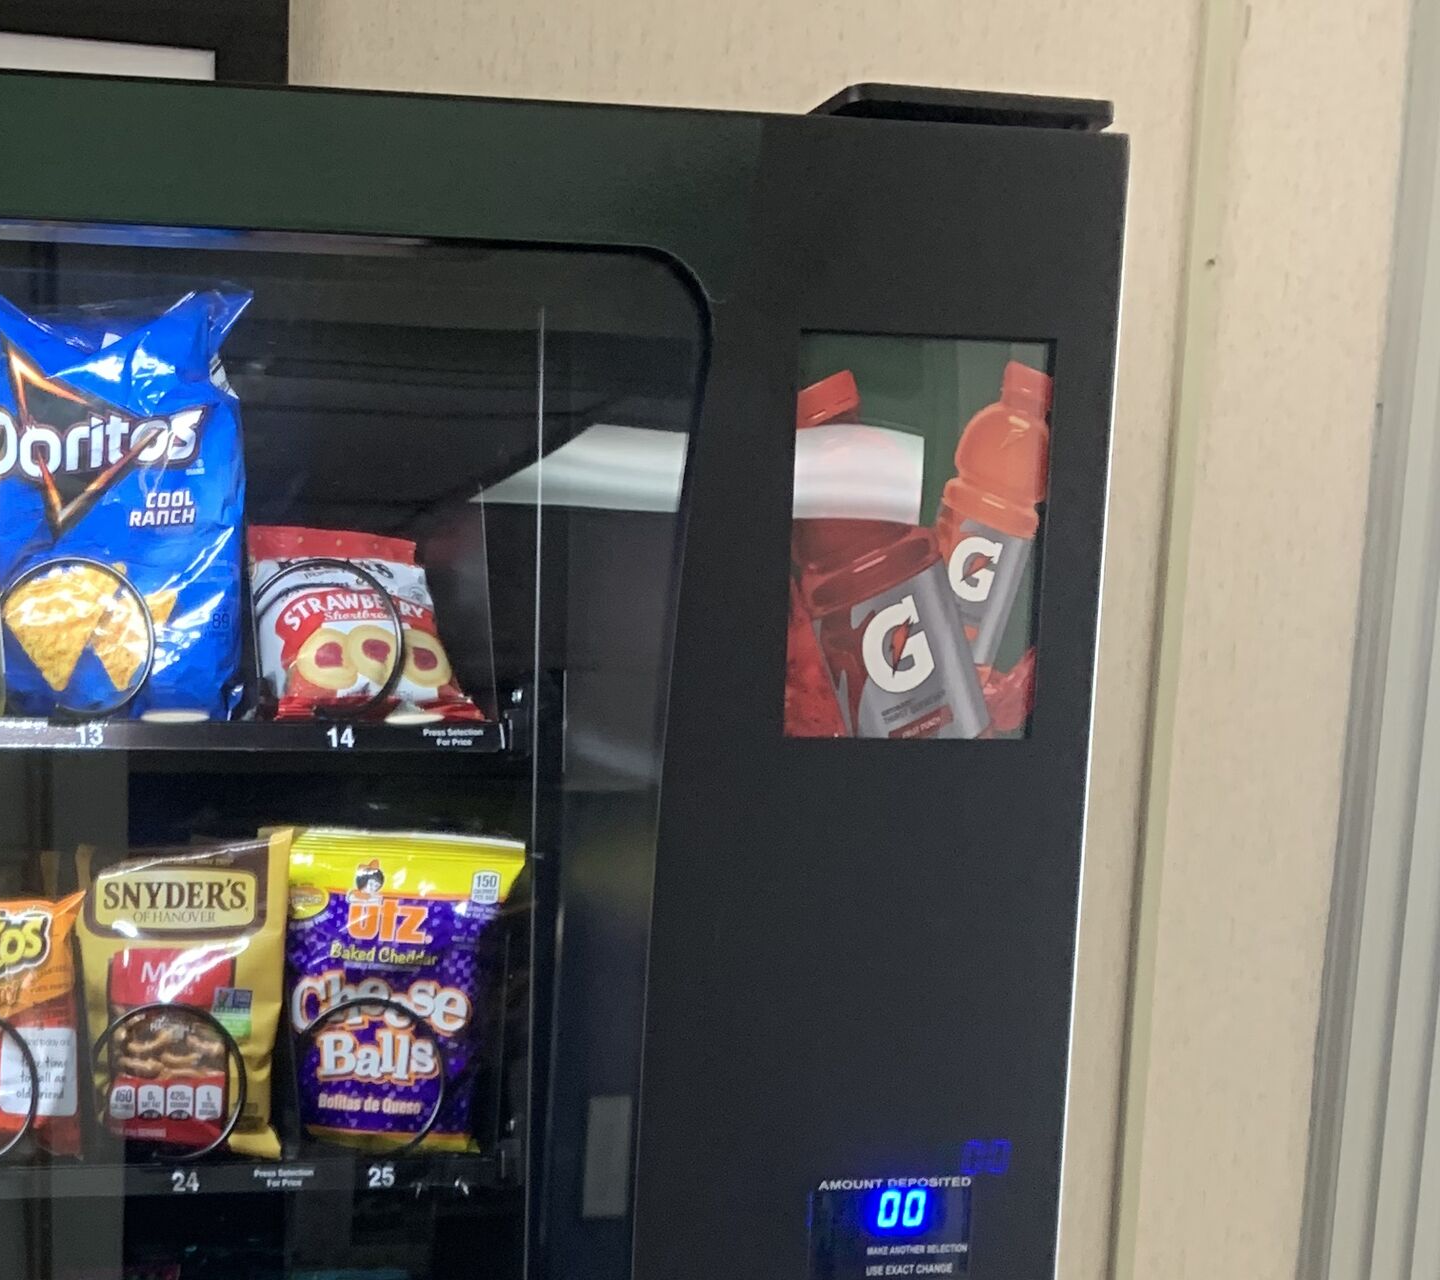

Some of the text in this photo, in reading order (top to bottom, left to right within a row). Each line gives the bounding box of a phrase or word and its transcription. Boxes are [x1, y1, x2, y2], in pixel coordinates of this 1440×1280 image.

[146, 490, 194, 508] COOL
[129, 508, 196, 527] RANCH
[947, 536, 1003, 602] G
[283, 592, 425, 632] STRAWBERY
[861, 594, 935, 693] G
[76, 724, 104, 746] 13
[326, 726, 355, 748] 14
[476, 874, 498, 888] 150
[103, 878, 247, 912] SNYDER'S
[133, 911, 215, 923] OF HANOVER
[330, 940, 438, 967] Baked Cheddar
[319, 1030, 435, 1080] Balls
[364, 1096, 379, 1113] de
[382, 1098, 421, 1115] Queso
[172, 1171, 199, 1192] 24
[368, 1167, 395, 1188] 25
[818, 1175, 972, 1191] AMOUNT DEPOSITED
[877, 1189, 927, 1228] 00
[866, 1243, 968, 1256] MAKE ANOTHER SELECTION
[865, 1262, 953, 1276] USE EXACT CHANGE
